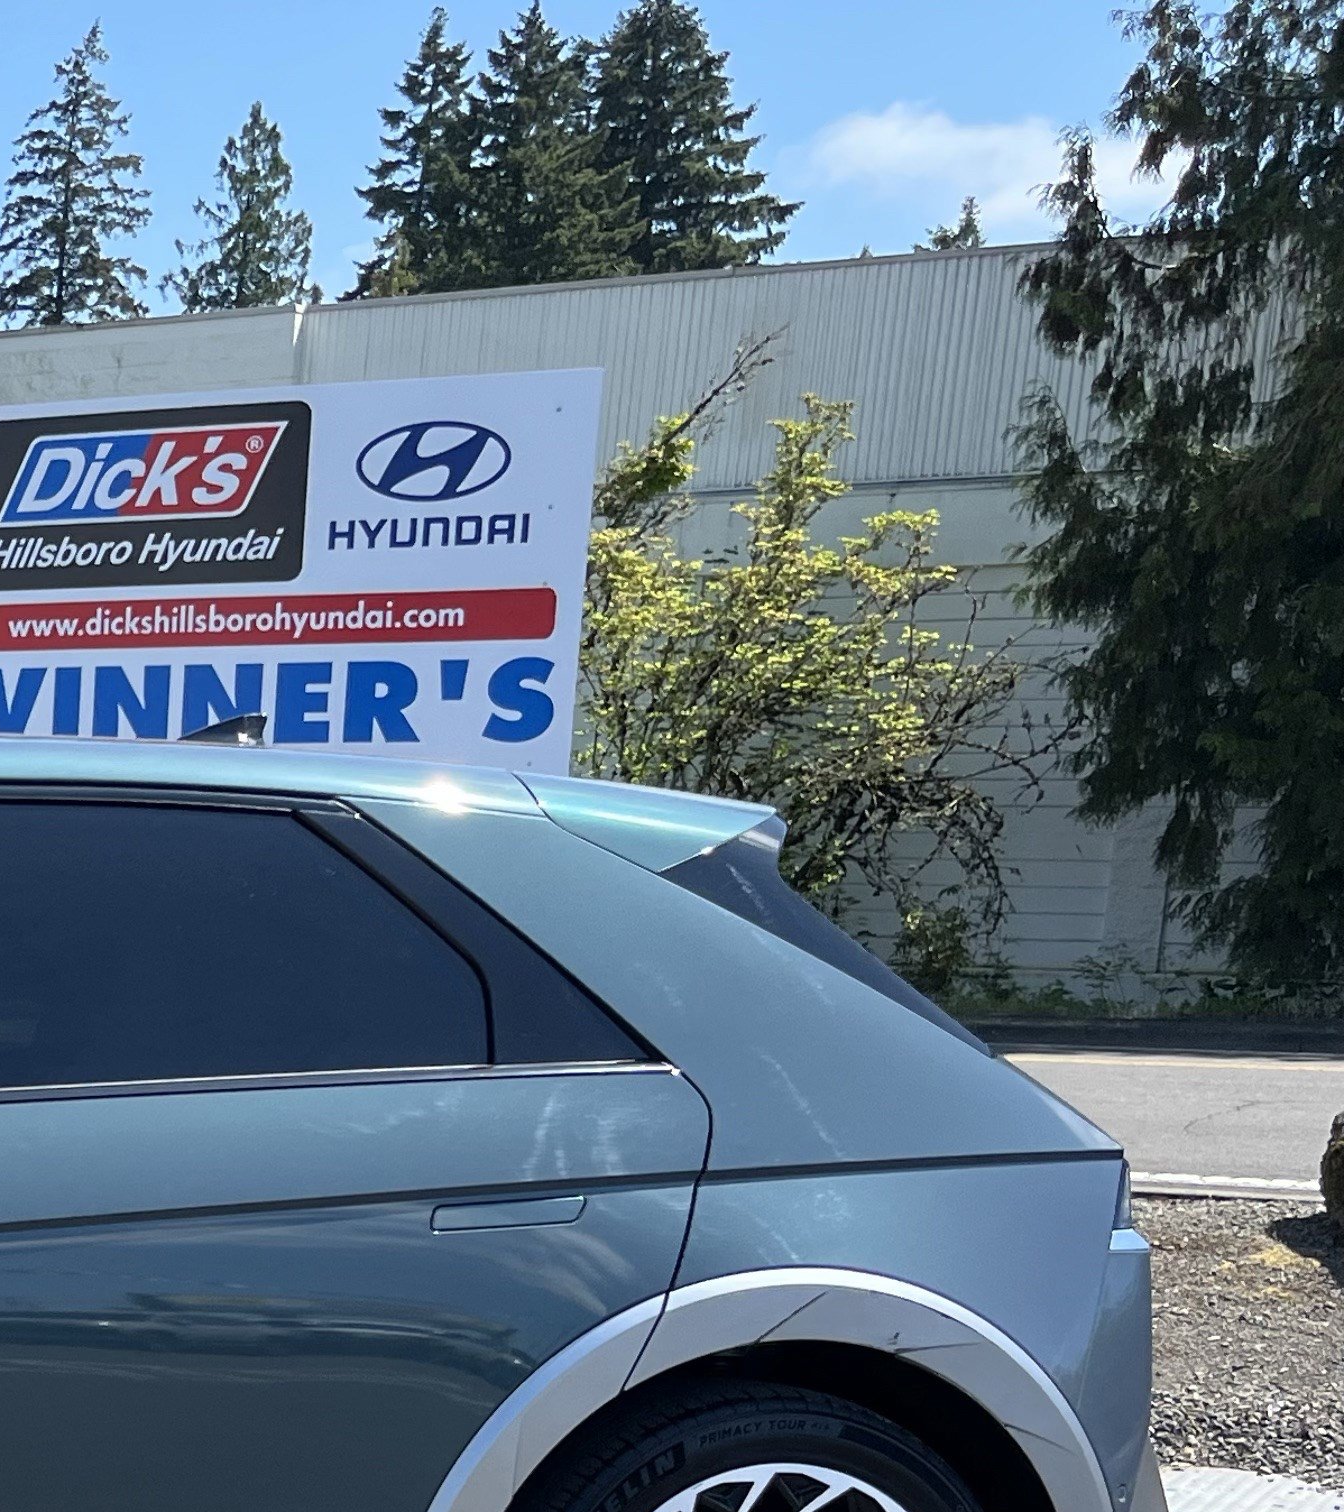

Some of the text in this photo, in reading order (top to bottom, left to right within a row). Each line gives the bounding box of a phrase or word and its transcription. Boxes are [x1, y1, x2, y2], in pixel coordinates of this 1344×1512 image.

[17, 436, 248, 513] Dick's
[138, 527, 285, 572] Hyundai
[328, 513, 530, 550] HYUNDAI
[8, 601, 466, 640] www.dickshillsborohyundai.com
[699, 1421, 761, 1448] PRIMACY
[768, 1419, 807, 1431] TOUR
